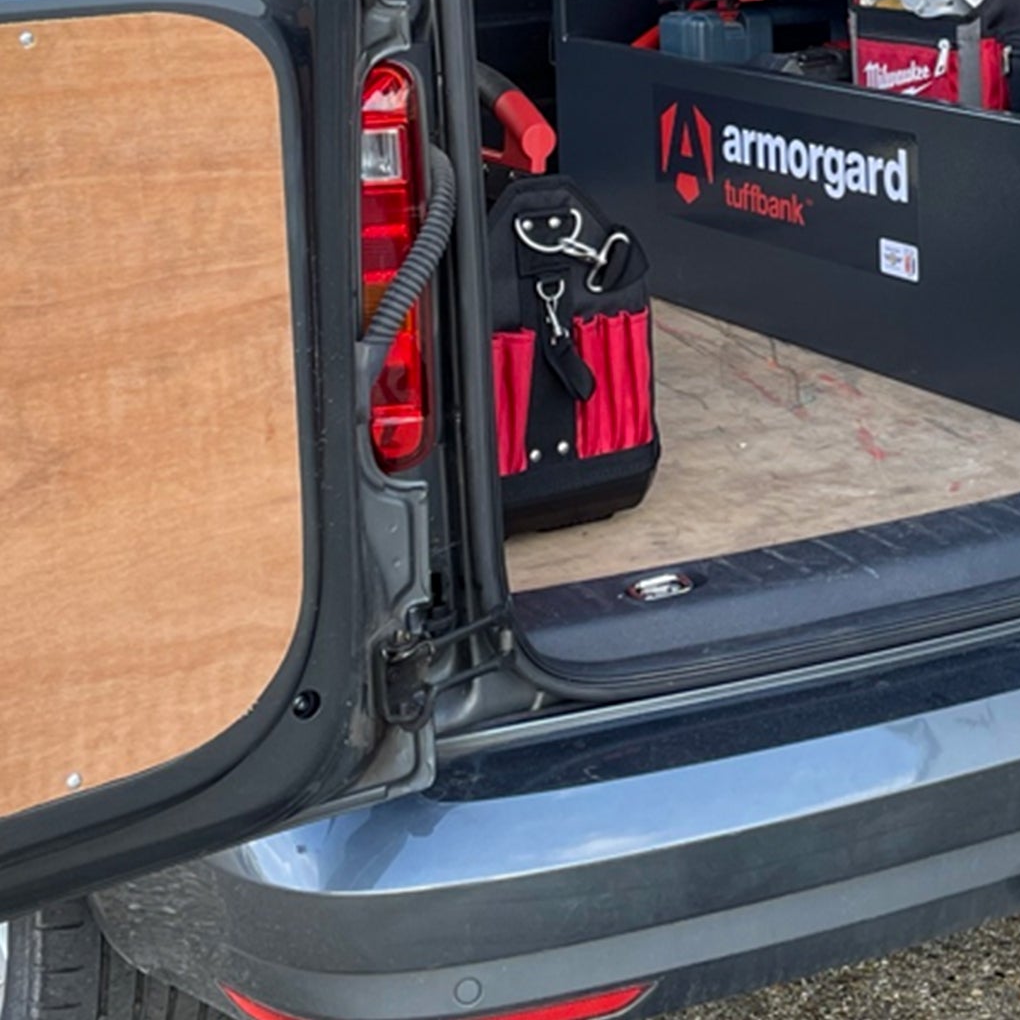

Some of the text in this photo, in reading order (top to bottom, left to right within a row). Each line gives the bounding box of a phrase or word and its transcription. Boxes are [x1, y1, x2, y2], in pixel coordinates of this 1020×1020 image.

[863, 61, 931, 90] Milwaukee
[722, 124, 909, 203] armorgard
[724, 178, 806, 226] tuffbank
